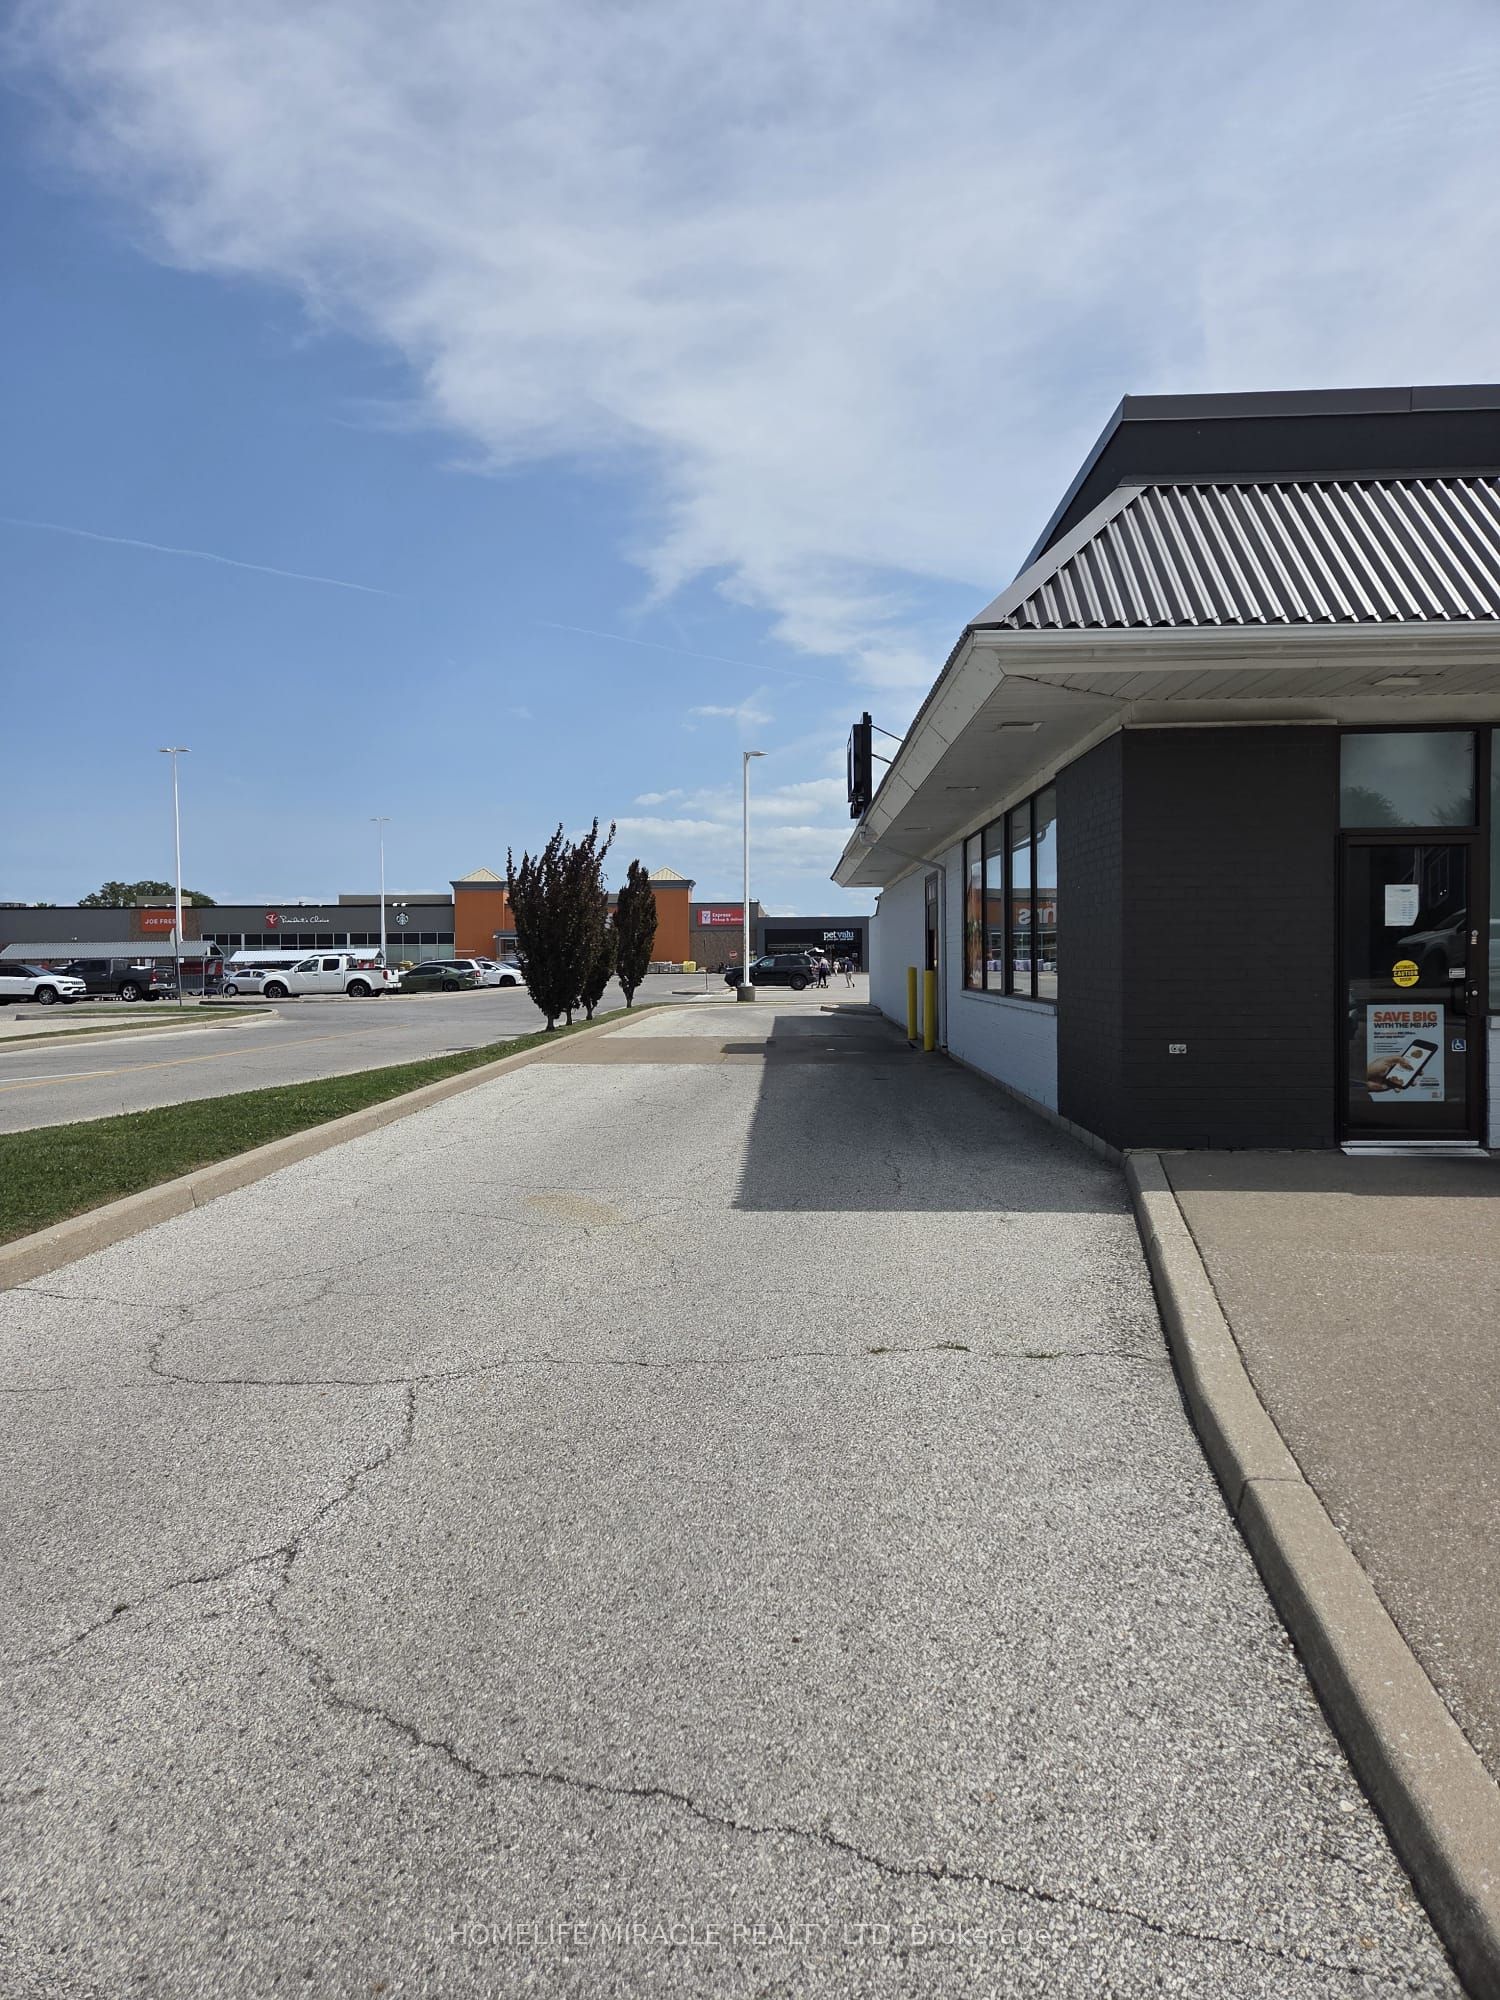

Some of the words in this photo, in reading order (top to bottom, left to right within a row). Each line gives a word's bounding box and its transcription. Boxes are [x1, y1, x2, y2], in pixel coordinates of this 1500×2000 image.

[823, 930, 836, 941] pet
[837, 930, 855, 938] valu
[1373, 1011, 1410, 1022] SAVE
[1411, 1011, 1437, 1022] BIG
